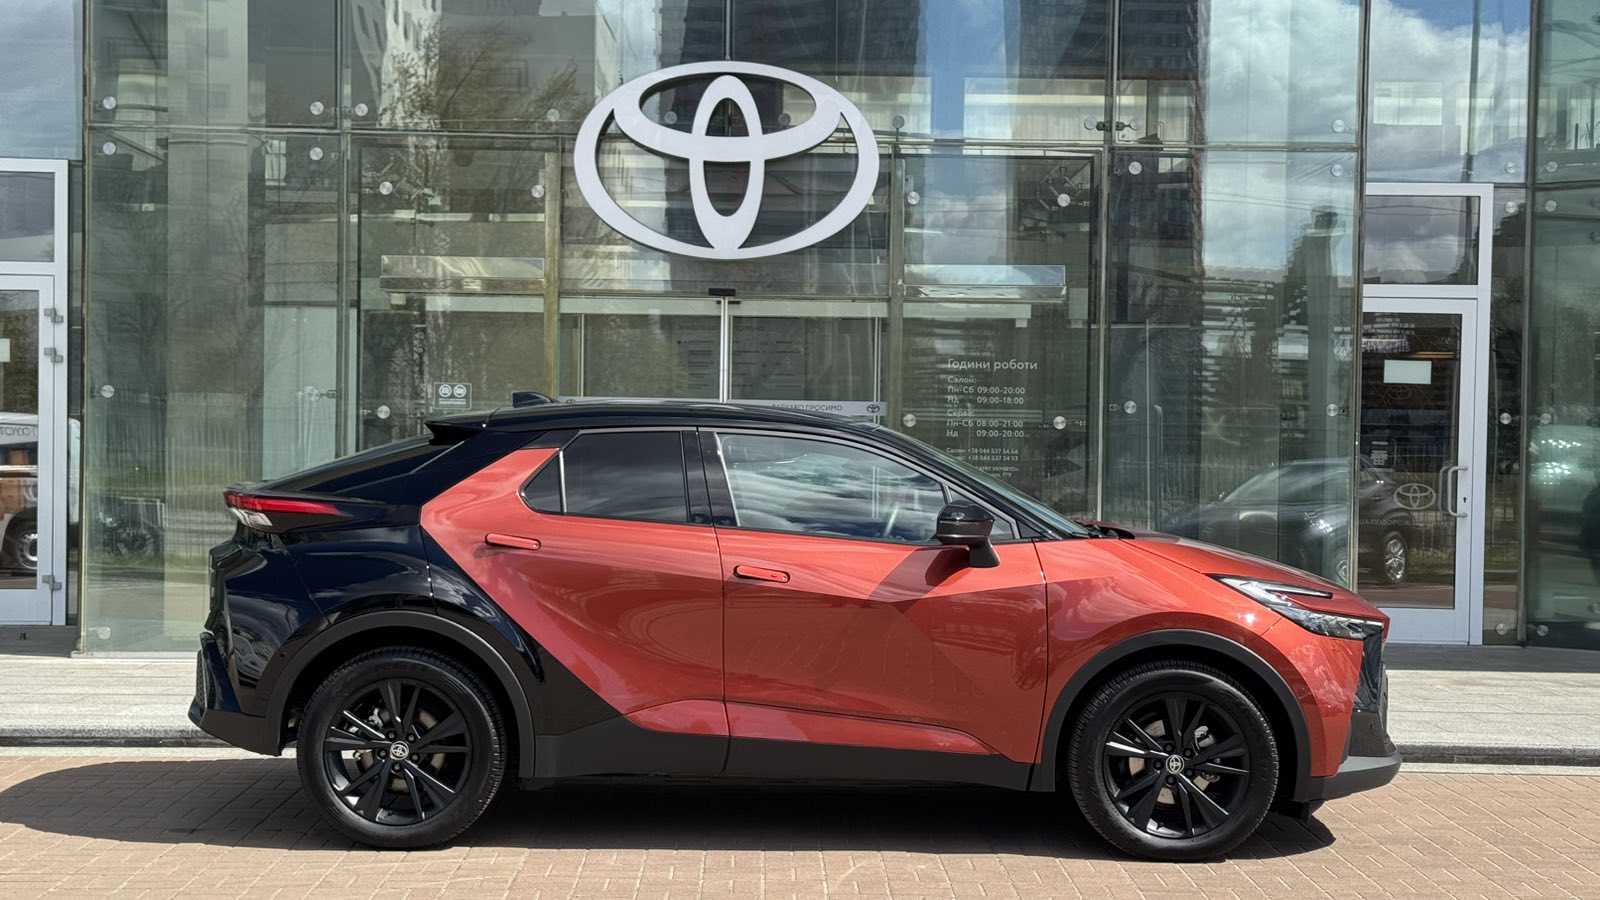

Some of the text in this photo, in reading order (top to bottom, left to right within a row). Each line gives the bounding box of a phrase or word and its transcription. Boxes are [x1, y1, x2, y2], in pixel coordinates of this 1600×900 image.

[947, 358, 1038, 371] Години роботи
[947, 385, 974, 394] Пн-Сб
[946, 418, 974, 427] Пн-Сб
[946, 429, 959, 438] Нд
